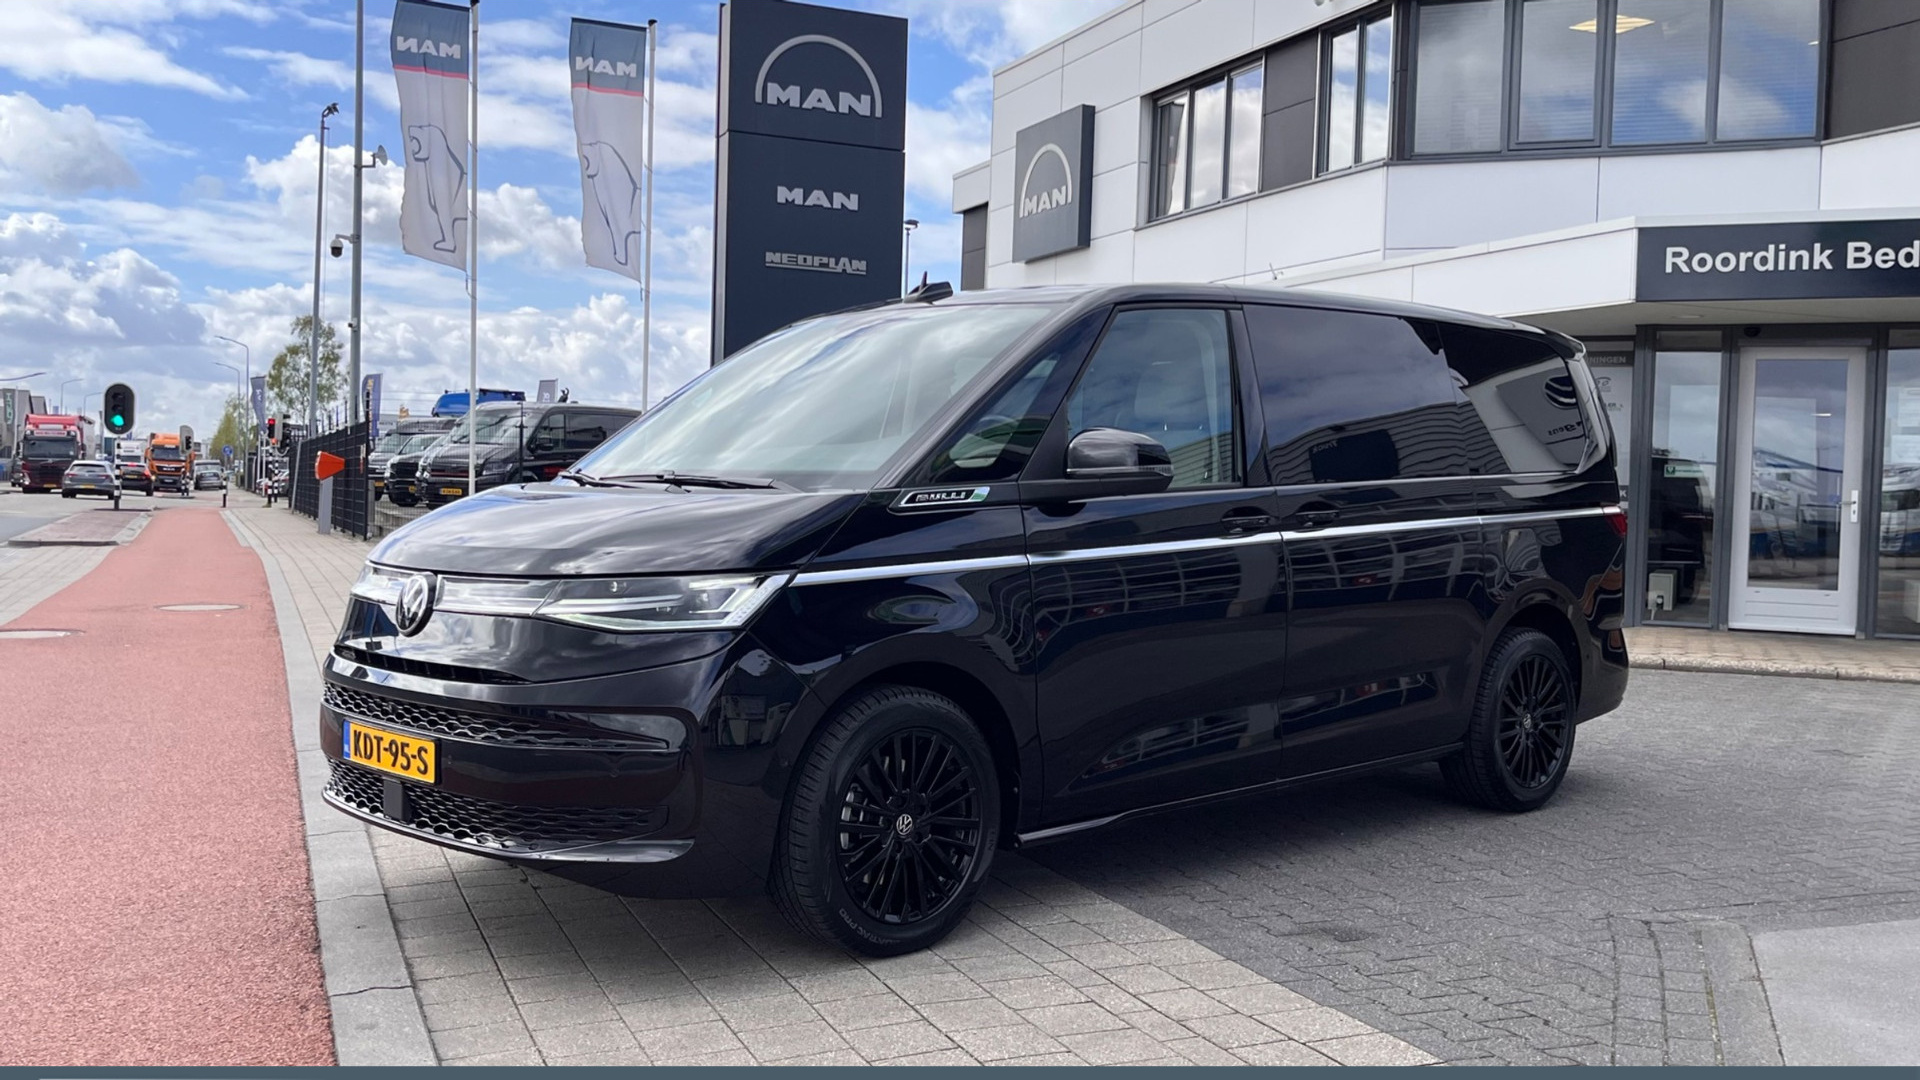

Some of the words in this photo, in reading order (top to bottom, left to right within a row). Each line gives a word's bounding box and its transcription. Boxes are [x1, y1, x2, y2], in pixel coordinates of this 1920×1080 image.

[767, 82, 871, 117] MAN
[777, 185, 859, 211] MAN
[1024, 185, 1066, 217] MAN
[765, 251, 867, 275] NEOPLAN
[1665, 243, 1834, 273] Roordink
[1846, 240, 1920, 269] Bed
[353, 729, 429, 775] KDT-95-S
